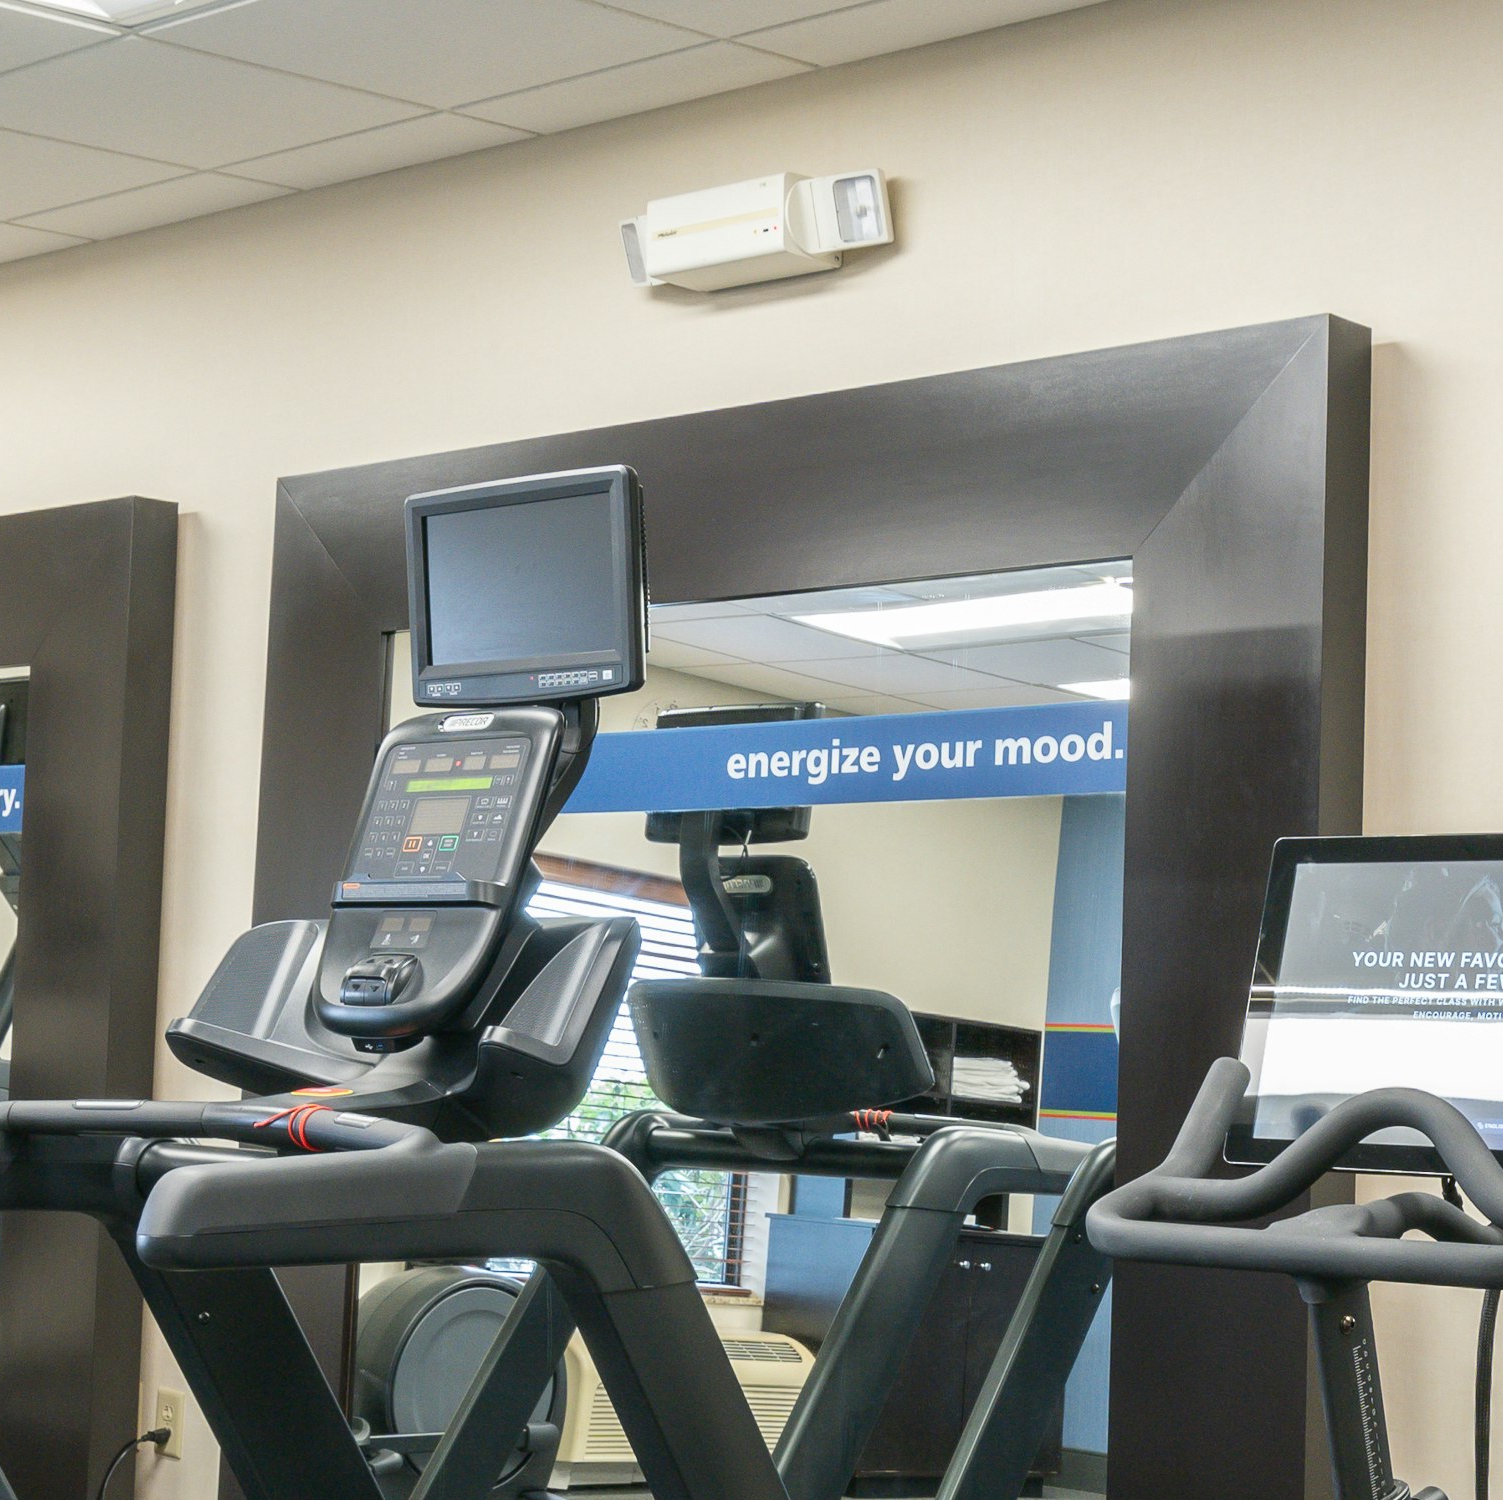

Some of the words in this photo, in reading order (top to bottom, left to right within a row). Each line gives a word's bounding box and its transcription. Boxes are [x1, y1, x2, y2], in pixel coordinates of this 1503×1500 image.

[726, 738, 881, 786] energize
[892, 740, 982, 782] your
[994, 720, 1125, 765] mood.
[1352, 951, 1404, 967] YOUR
[1409, 952, 1456, 968] NEW
[1398, 973, 1450, 989] JUST
[1454, 973, 1468, 989] A
[1347, 995, 1370, 1004] FIND
[1372, 996, 1390, 1005] THE
[1392, 996, 1434, 1005] PERFECT
[1436, 997, 1467, 1006] CLASS
[1470, 998, 1497, 1006] WITH
[1413, 1011, 1474, 1021] ENCOURAGE,
